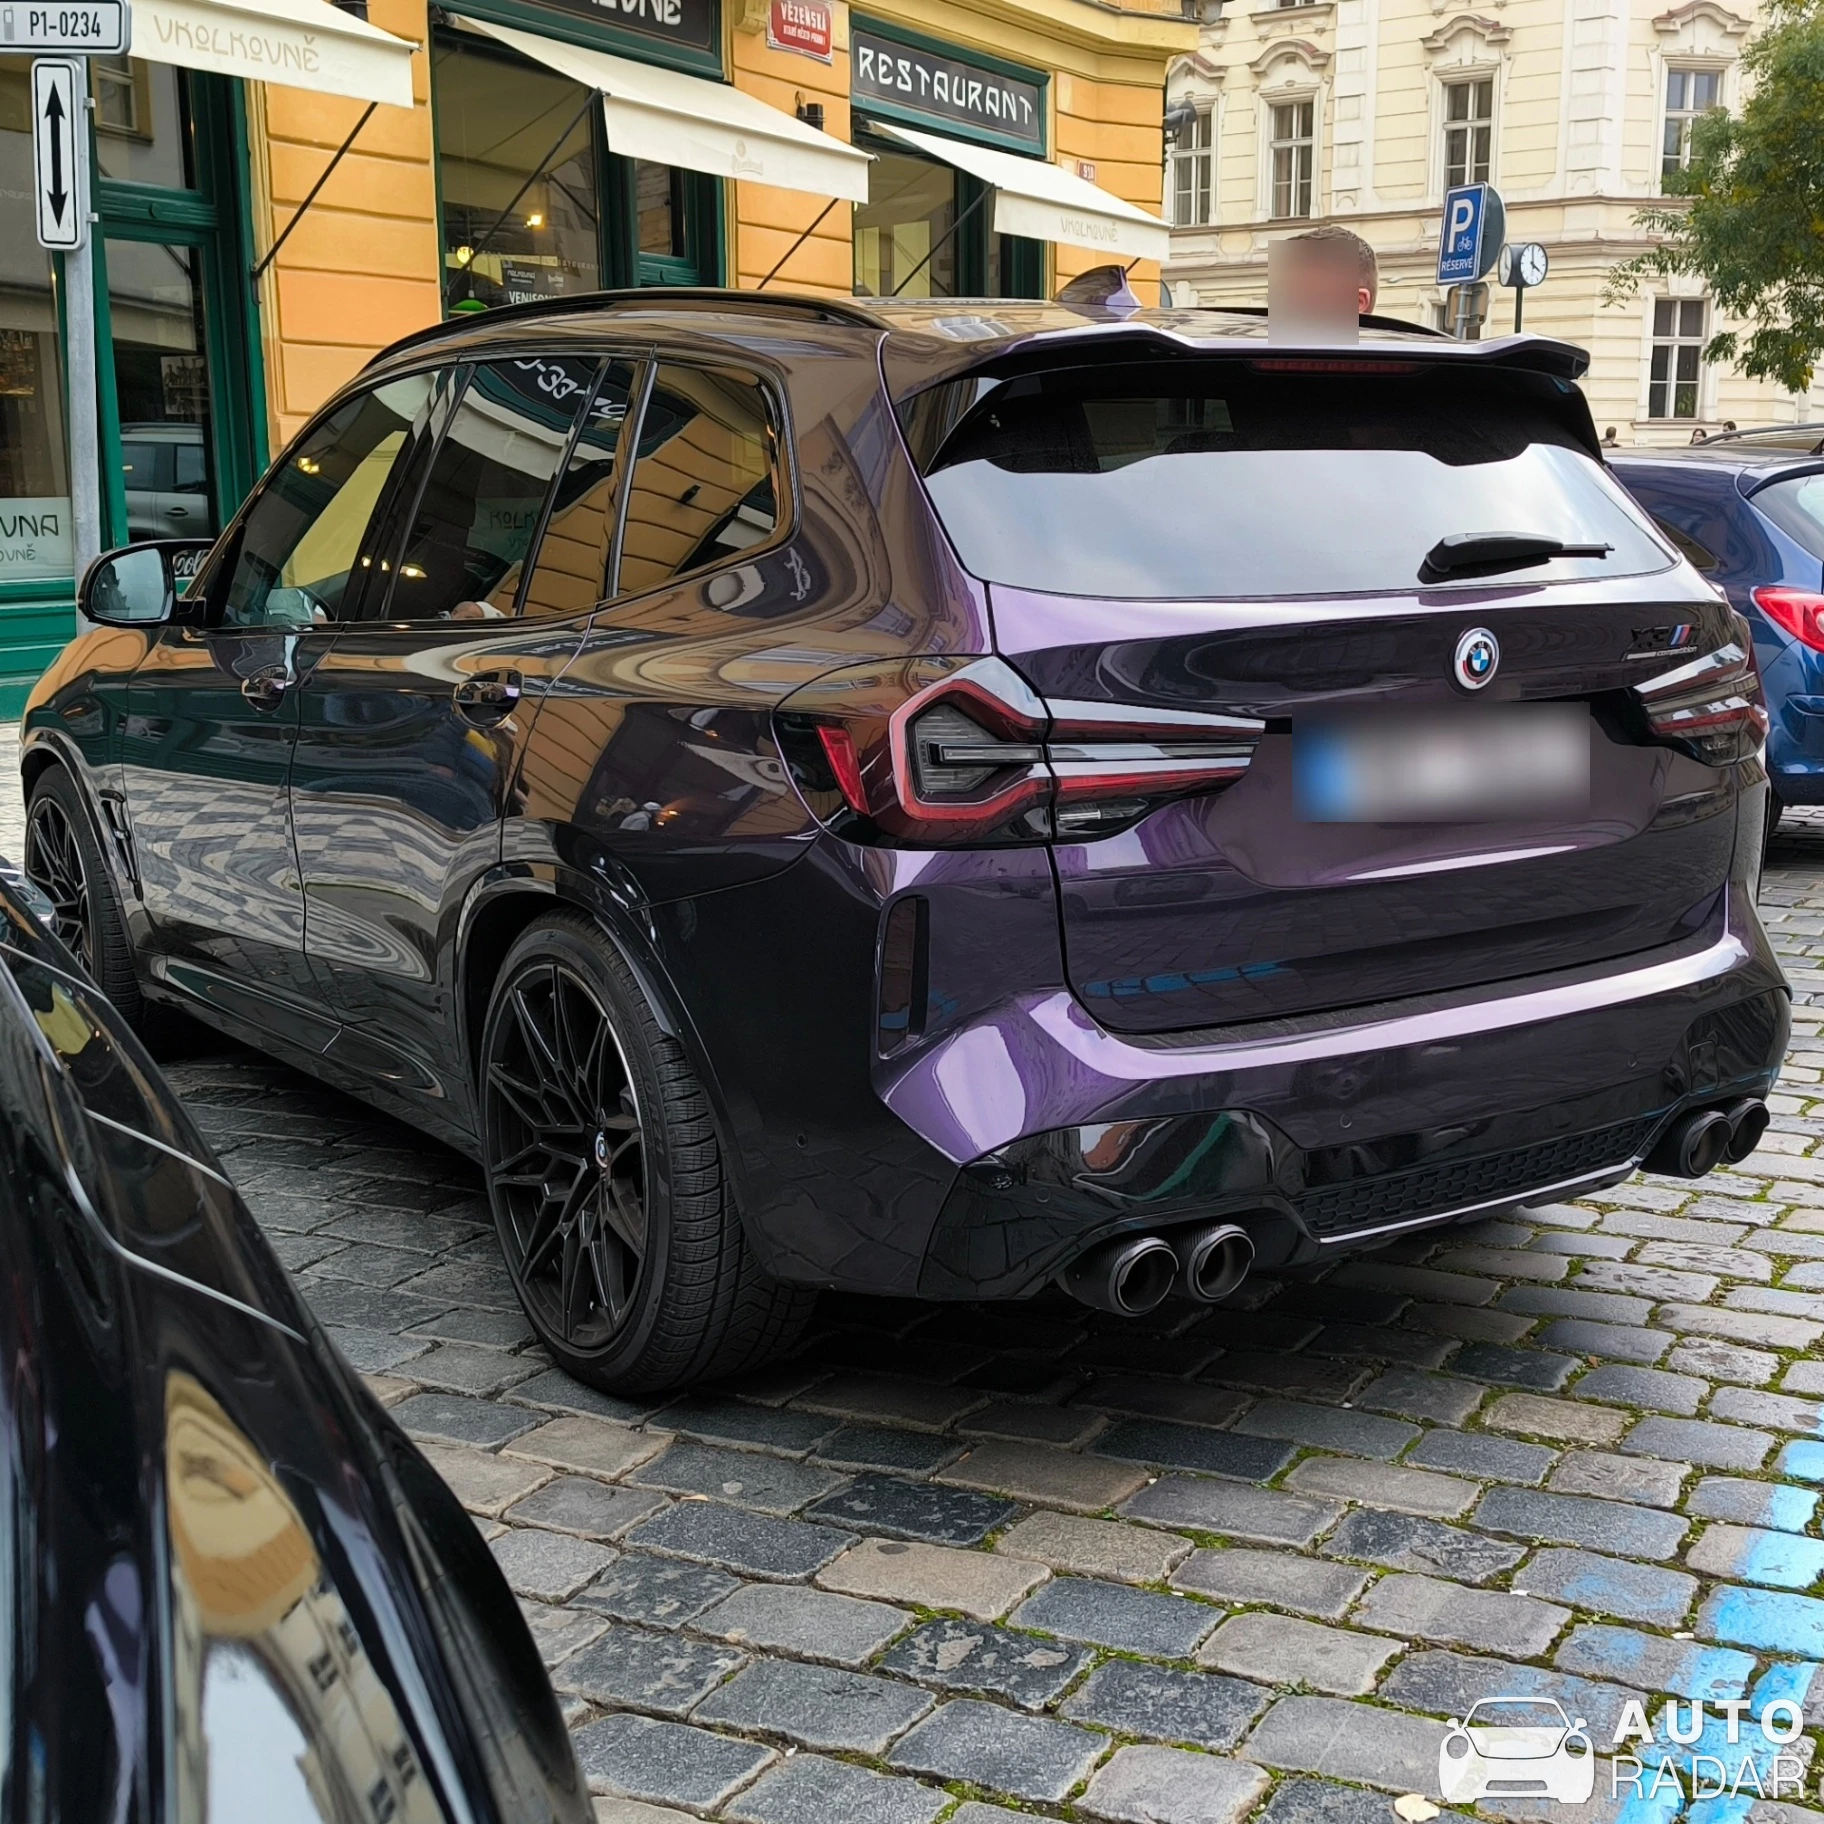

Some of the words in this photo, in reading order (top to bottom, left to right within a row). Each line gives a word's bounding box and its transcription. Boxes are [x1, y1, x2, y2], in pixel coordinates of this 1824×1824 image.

[30, 11, 101, 37] P1-0234
[858, 46, 1033, 125] RESTAURANT
[1447, 198, 1474, 253] P
[1441, 254, 1474, 272] RÉSERVÉ
